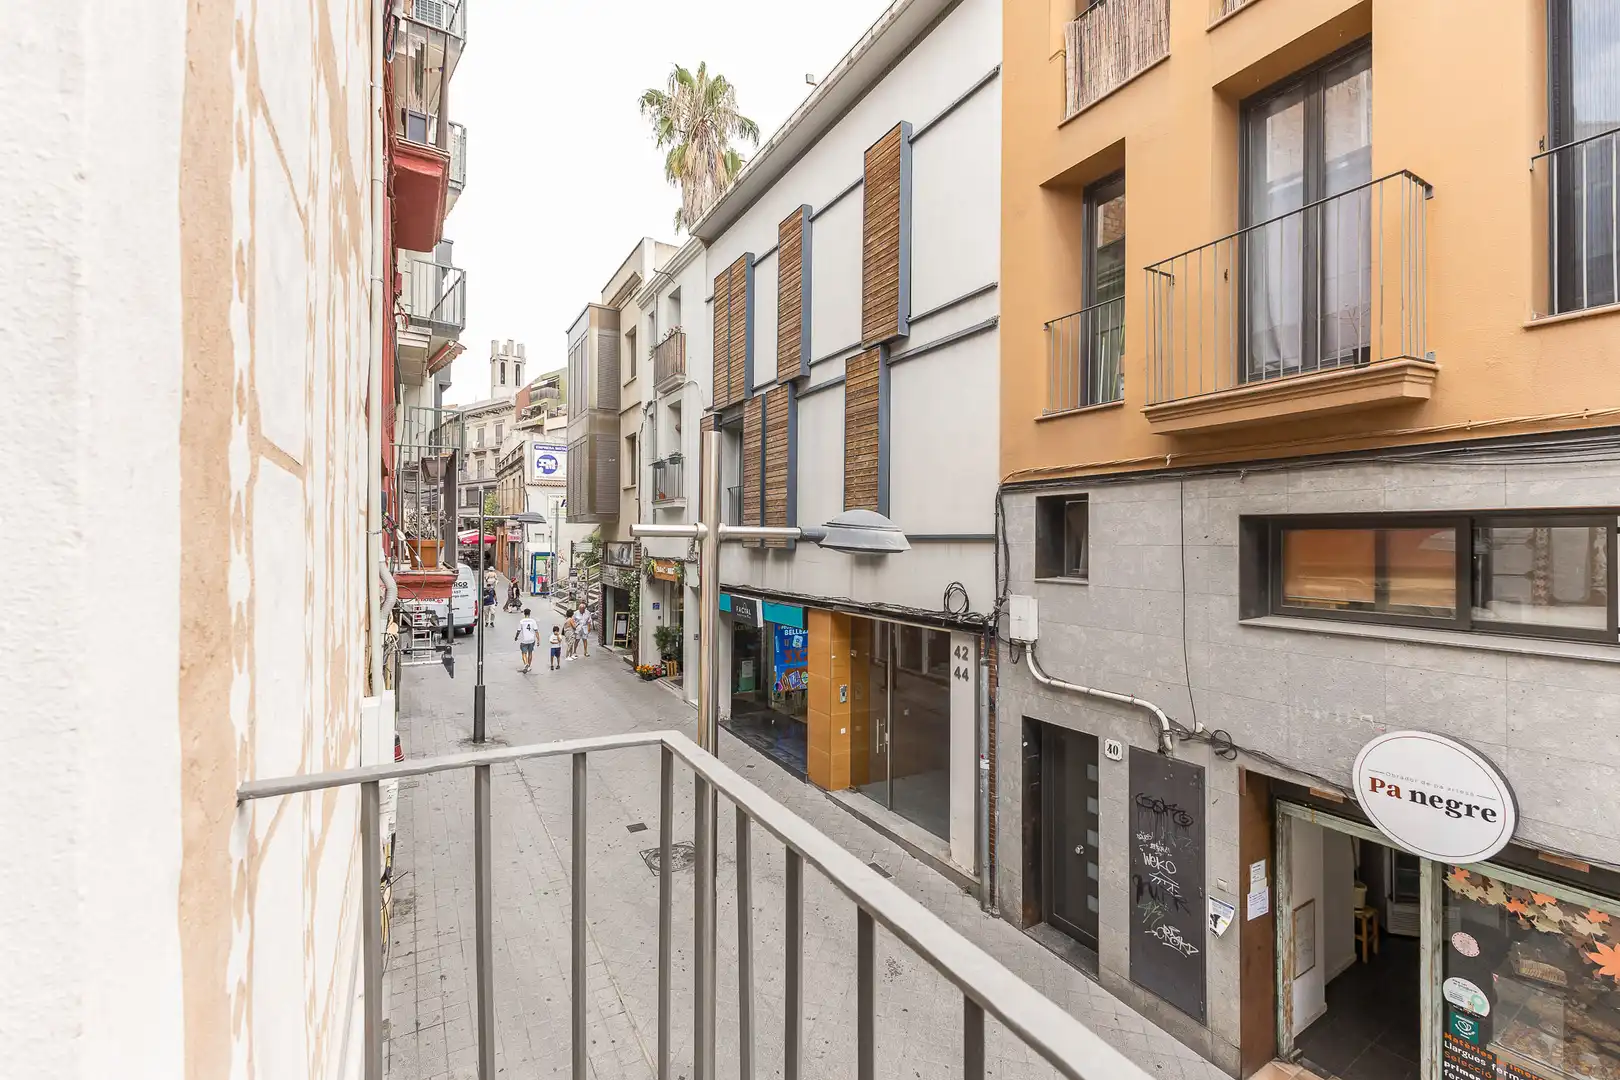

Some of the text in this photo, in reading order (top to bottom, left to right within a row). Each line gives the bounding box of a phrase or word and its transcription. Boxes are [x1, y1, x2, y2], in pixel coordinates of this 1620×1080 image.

[526, 623, 531, 631] 4
[953, 645, 969, 662] 42
[953, 665, 970, 682] 44
[1106, 743, 1119, 756] 40
[1385, 771, 1418, 783] Obrador
[1368, 776, 1497, 823] Pa negre
[1443, 1040, 1487, 1067] Llargues
[1443, 1051, 1493, 1079] Selecció
